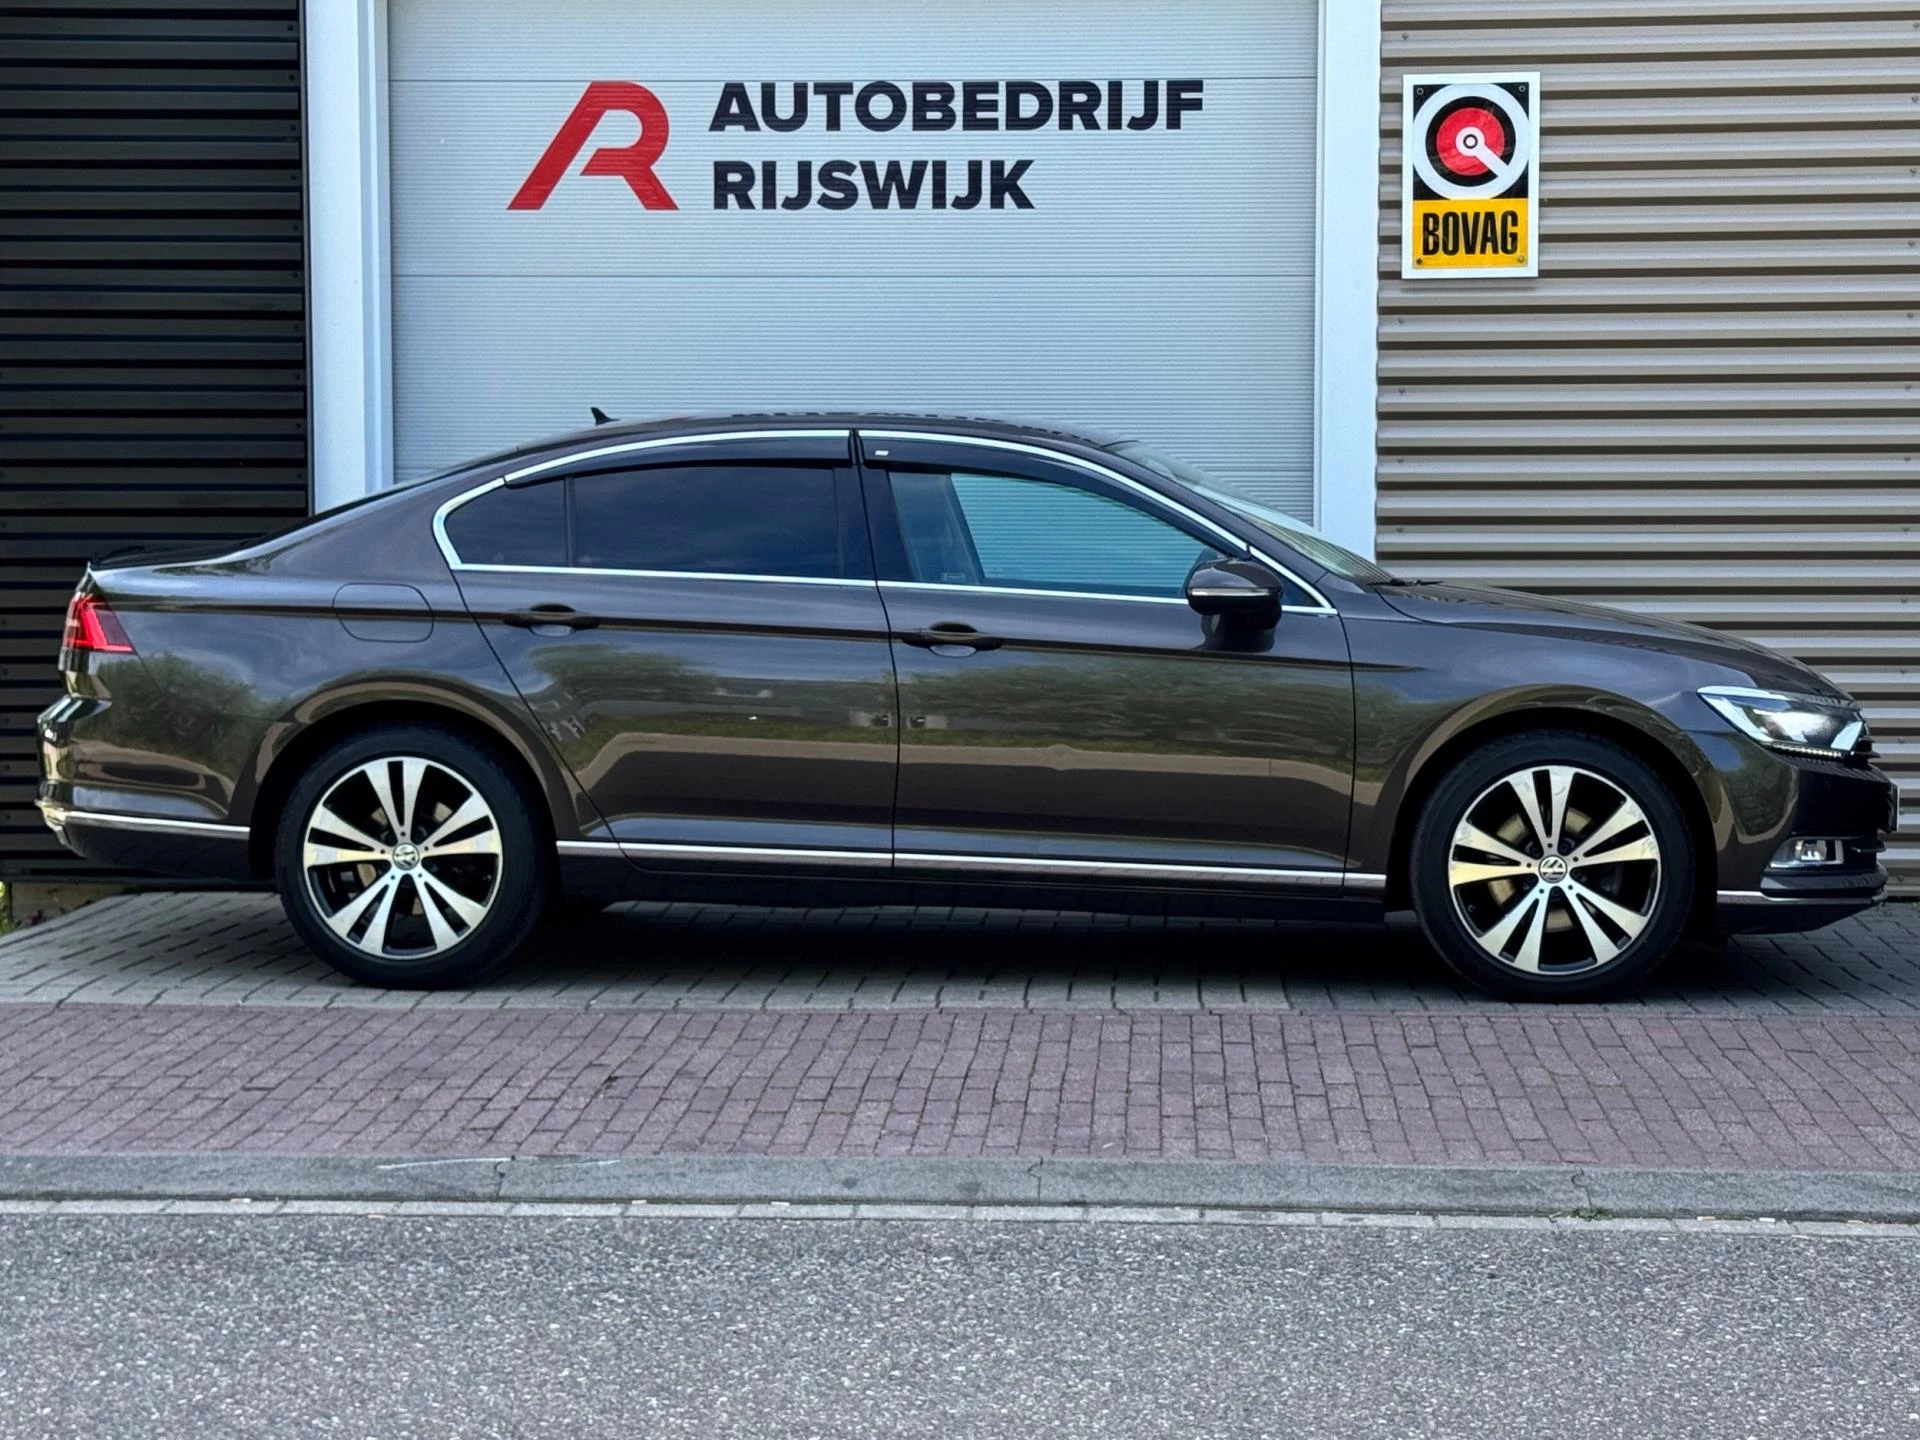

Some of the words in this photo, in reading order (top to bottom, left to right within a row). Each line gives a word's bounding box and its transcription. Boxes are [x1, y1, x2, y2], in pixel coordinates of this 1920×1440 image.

[709, 80, 1204, 132] AUTOBEDRIJF
[713, 159, 1036, 210] RIJSWIJK
[1421, 210, 1519, 256] BOVAG
